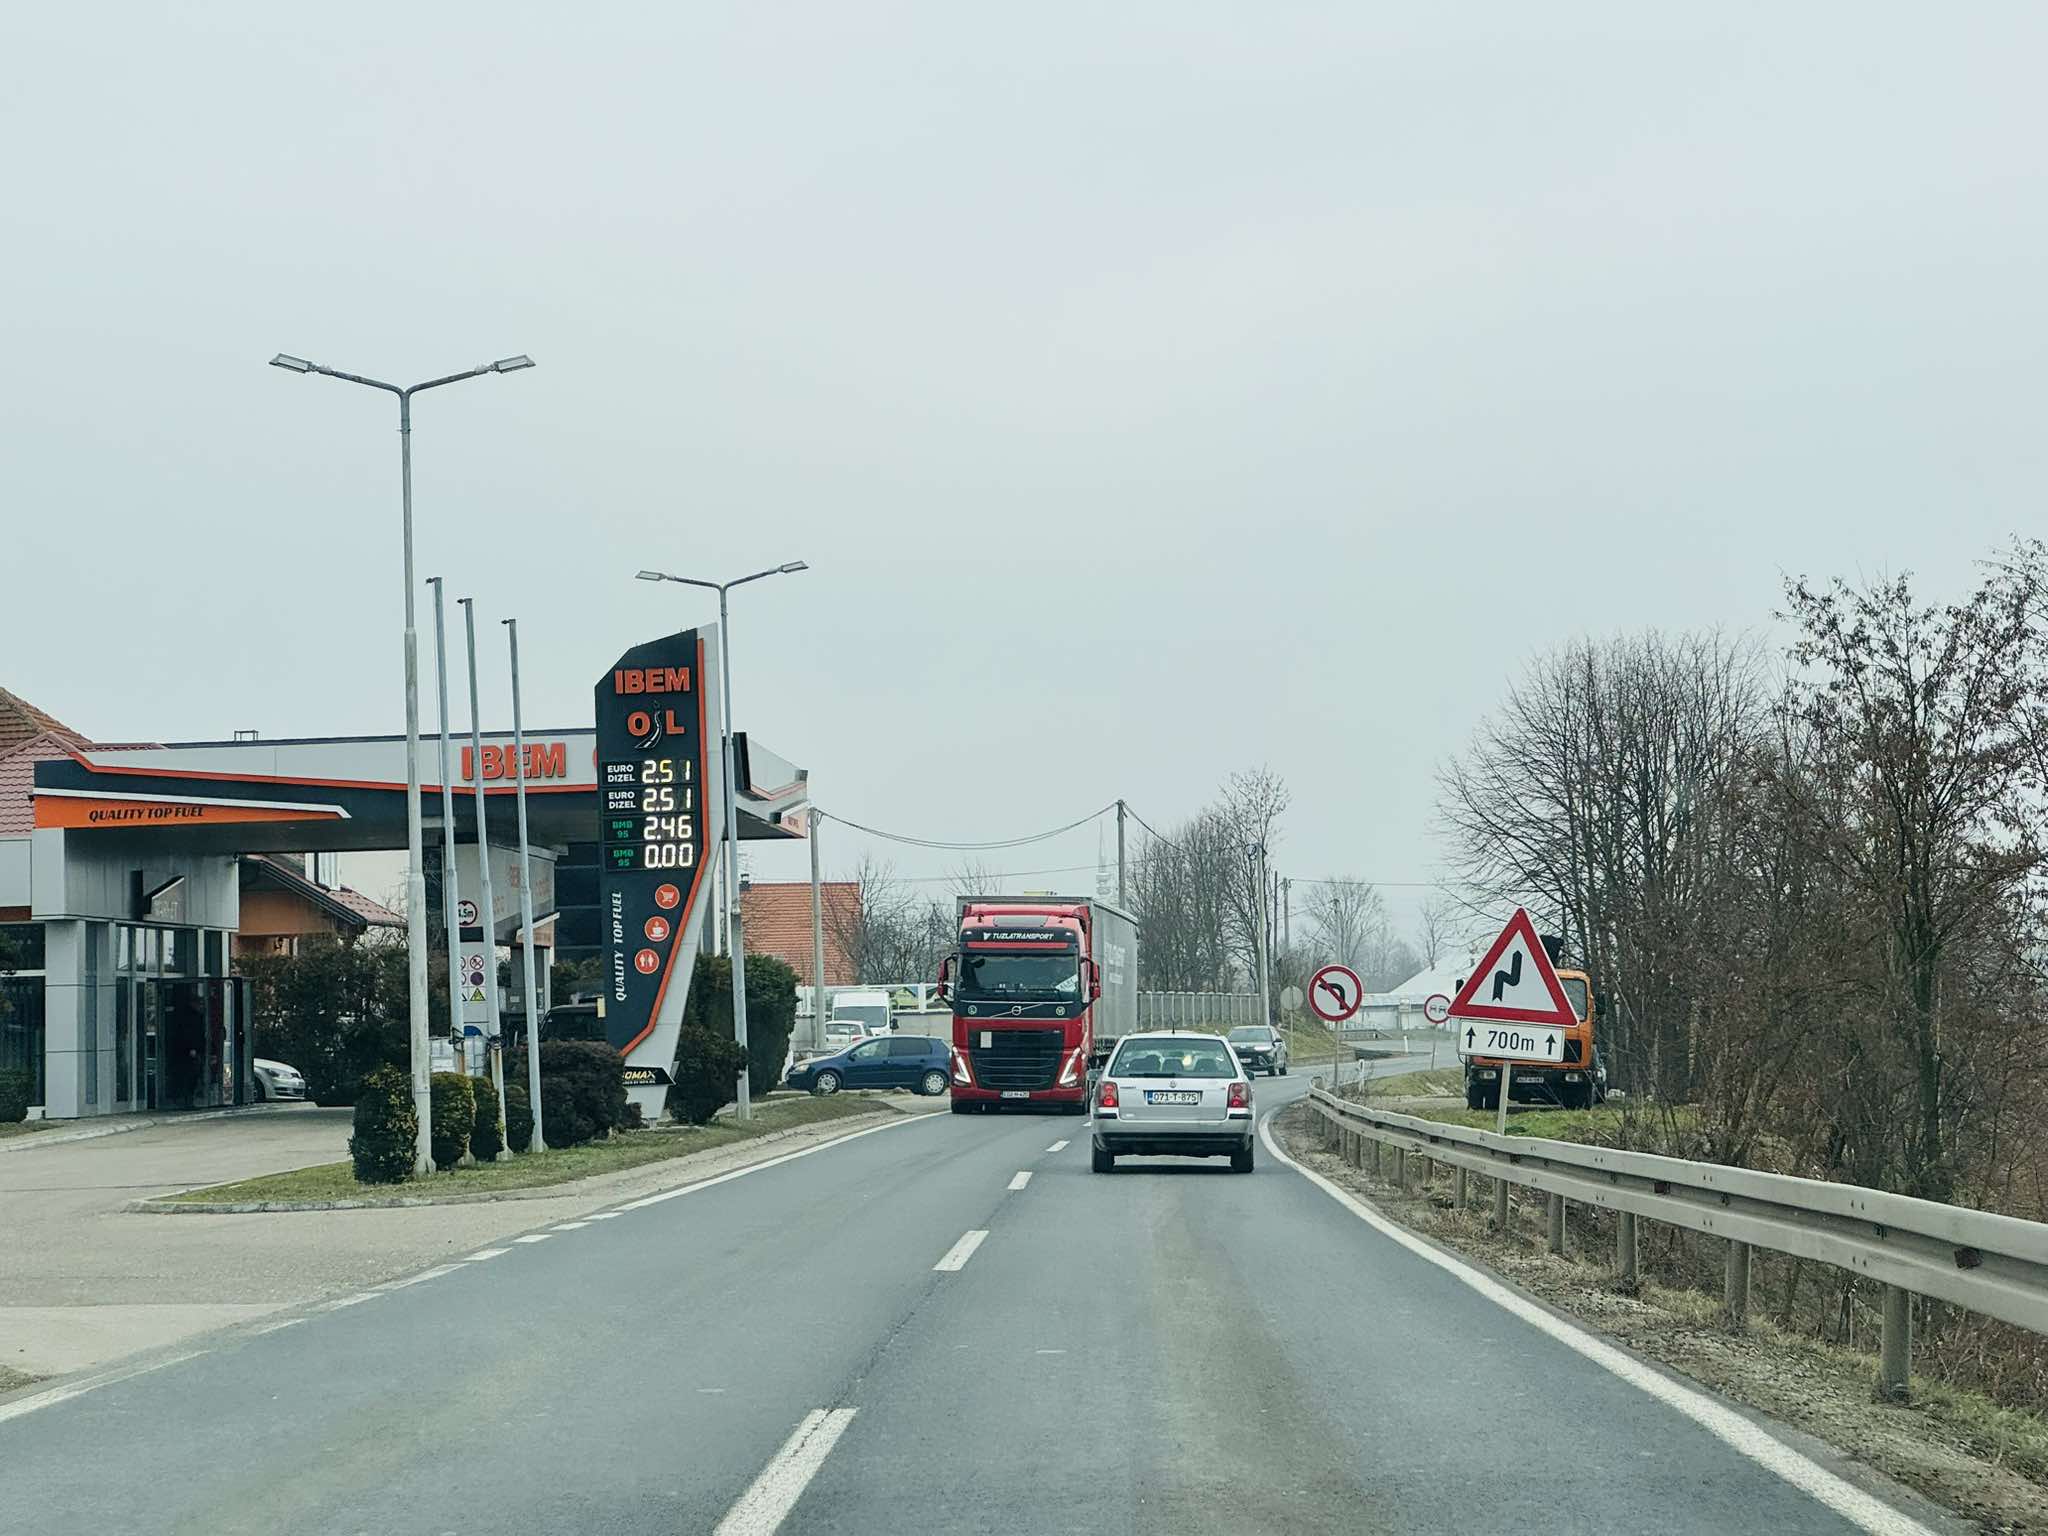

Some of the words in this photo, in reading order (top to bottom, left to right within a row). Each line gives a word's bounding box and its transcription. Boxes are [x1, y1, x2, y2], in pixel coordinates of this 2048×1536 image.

[614, 666, 690, 695] IBEM
[461, 742, 566, 780] IBEM
[607, 764, 634, 773] EURO
[642, 759, 691, 783] 2.51
[607, 774, 636, 783] DIZEL
[608, 791, 635, 800] EURO
[609, 801, 636, 809] DIZEL
[643, 787, 692, 812] 2.51
[88, 807, 145, 822] QUALITY
[147, 807, 172, 819] TOP
[175, 807, 204, 817] FUEL
[617, 830, 629, 839] 95
[643, 815, 693, 841] 2.46
[617, 858, 630, 867] 95
[644, 843, 693, 869] 0.00
[611, 891, 623, 919] FUEL
[613, 920, 624, 945] TOP
[992, 932, 1054, 940] TUZLATRANSPORT
[614, 950, 627, 1002] QUALITY
[1488, 1031, 1534, 1051] 700m
[1153, 1092, 1197, 1102] 071-T-875
